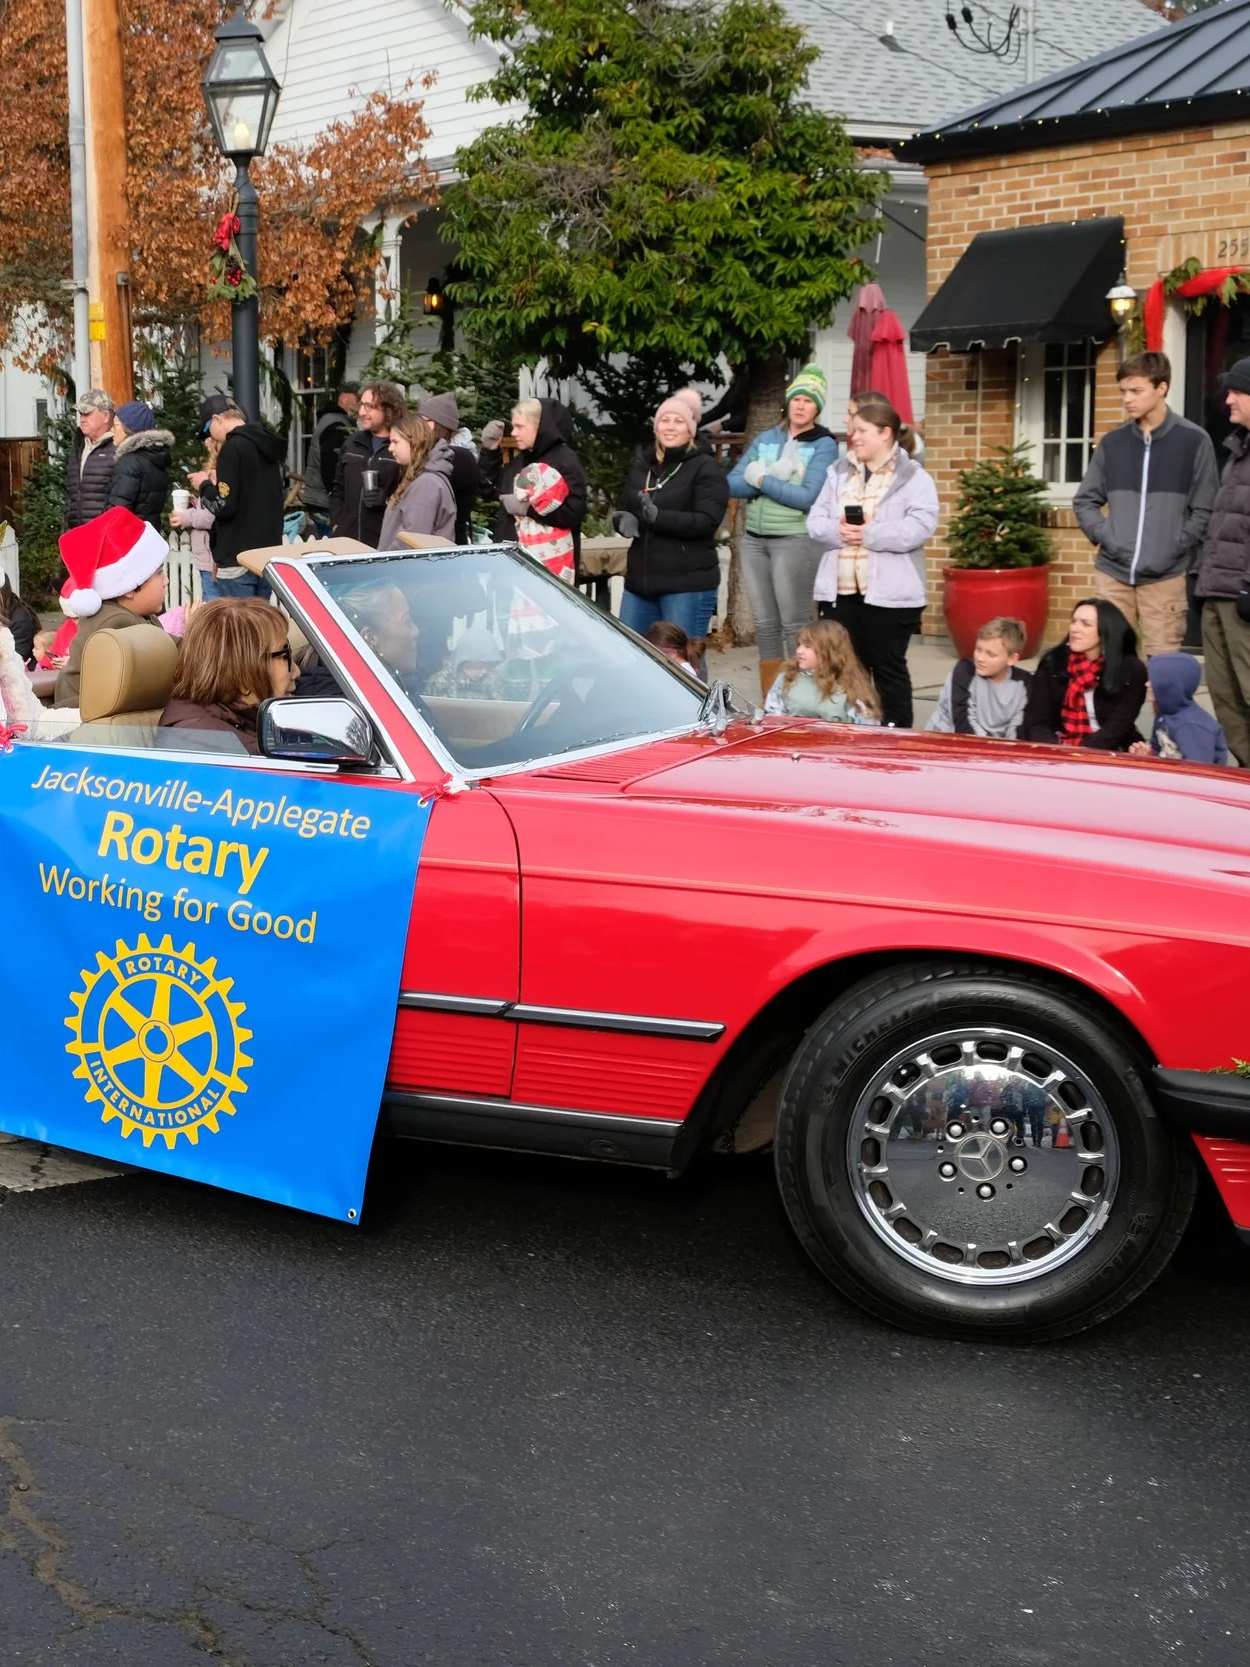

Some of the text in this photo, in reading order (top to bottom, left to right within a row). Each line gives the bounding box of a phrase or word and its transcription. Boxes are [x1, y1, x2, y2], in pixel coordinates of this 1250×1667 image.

[1217, 237, 1249, 258] 255
[31, 765, 371, 839] Jacksonville-Applegate
[97, 810, 270, 894] Rotary
[38, 863, 318, 944] Working for Good
[125, 957, 202, 985] ROTARY
[90, 1060, 221, 1126] INTERNATIONAL
